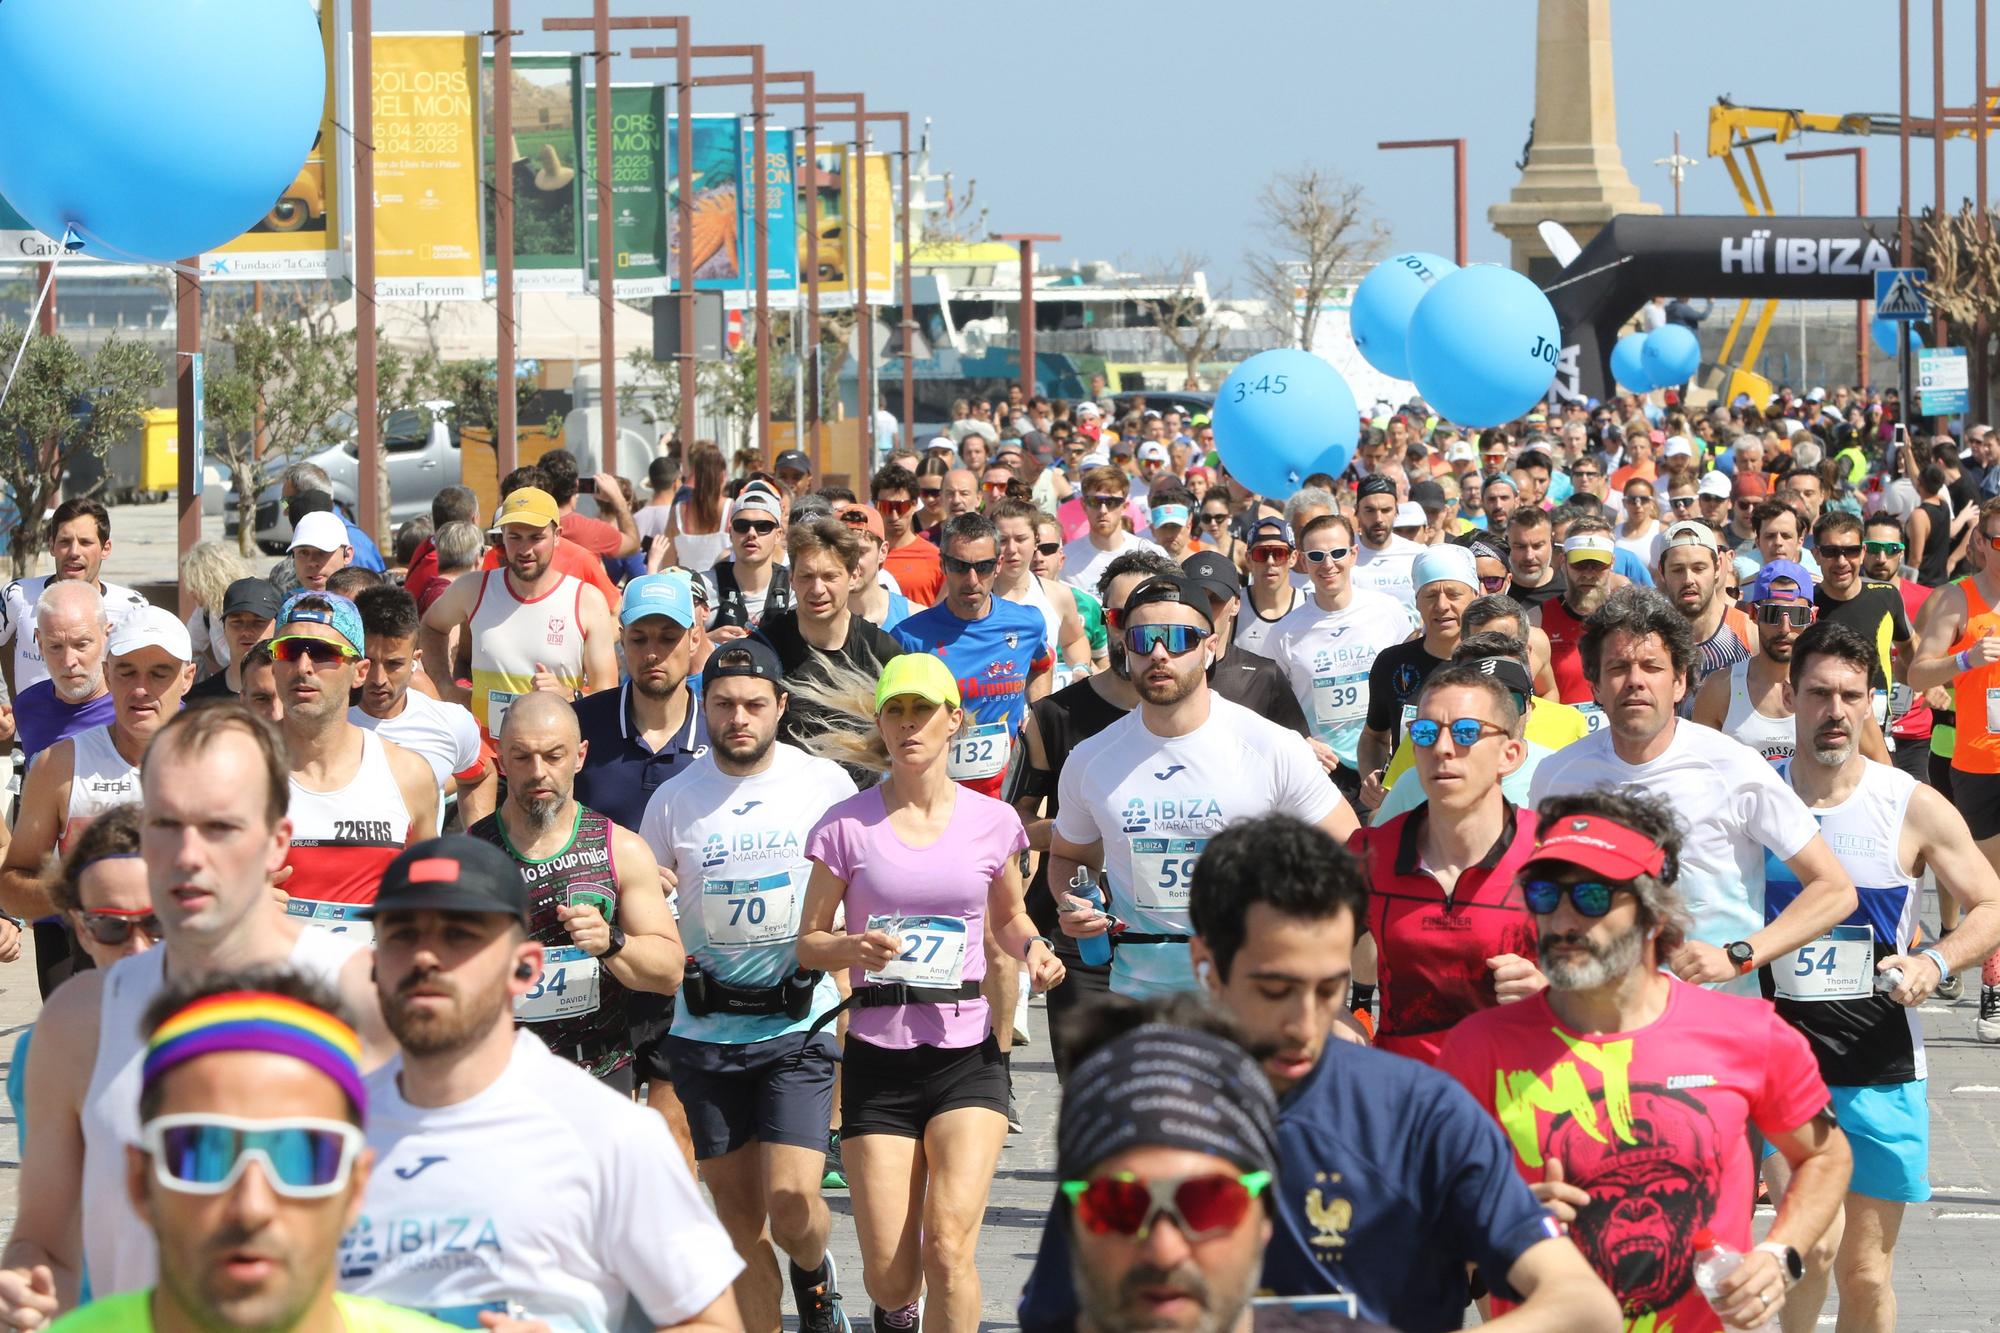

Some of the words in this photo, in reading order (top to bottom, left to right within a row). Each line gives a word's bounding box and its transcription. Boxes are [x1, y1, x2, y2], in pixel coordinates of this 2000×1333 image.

[1774, 237, 1892, 275] IBIZA
[374, 283, 465, 297] CaixaForum
[1233, 374, 1289, 404] 3:45
[1333, 646, 1378, 662] IBIZA
[1331, 686, 1358, 708] 39
[952, 739, 993, 765] 132
[1153, 799, 1224, 820] IBIZA
[334, 820, 392, 841] 226ERS
[1154, 818, 1225, 832] MARATHON
[732, 828, 799, 852] IBIZA
[537, 852, 578, 878] group
[731, 847, 800, 863] MARATHON
[727, 896, 767, 927] 70
[899, 933, 945, 964] 27
[929, 966, 950, 975] Anne
[1794, 946, 1838, 977] 54
[1826, 978, 1858, 986] Thomas
[560, 994, 588, 1005] DAVIDE
[386, 1216, 503, 1256] IBIZA
